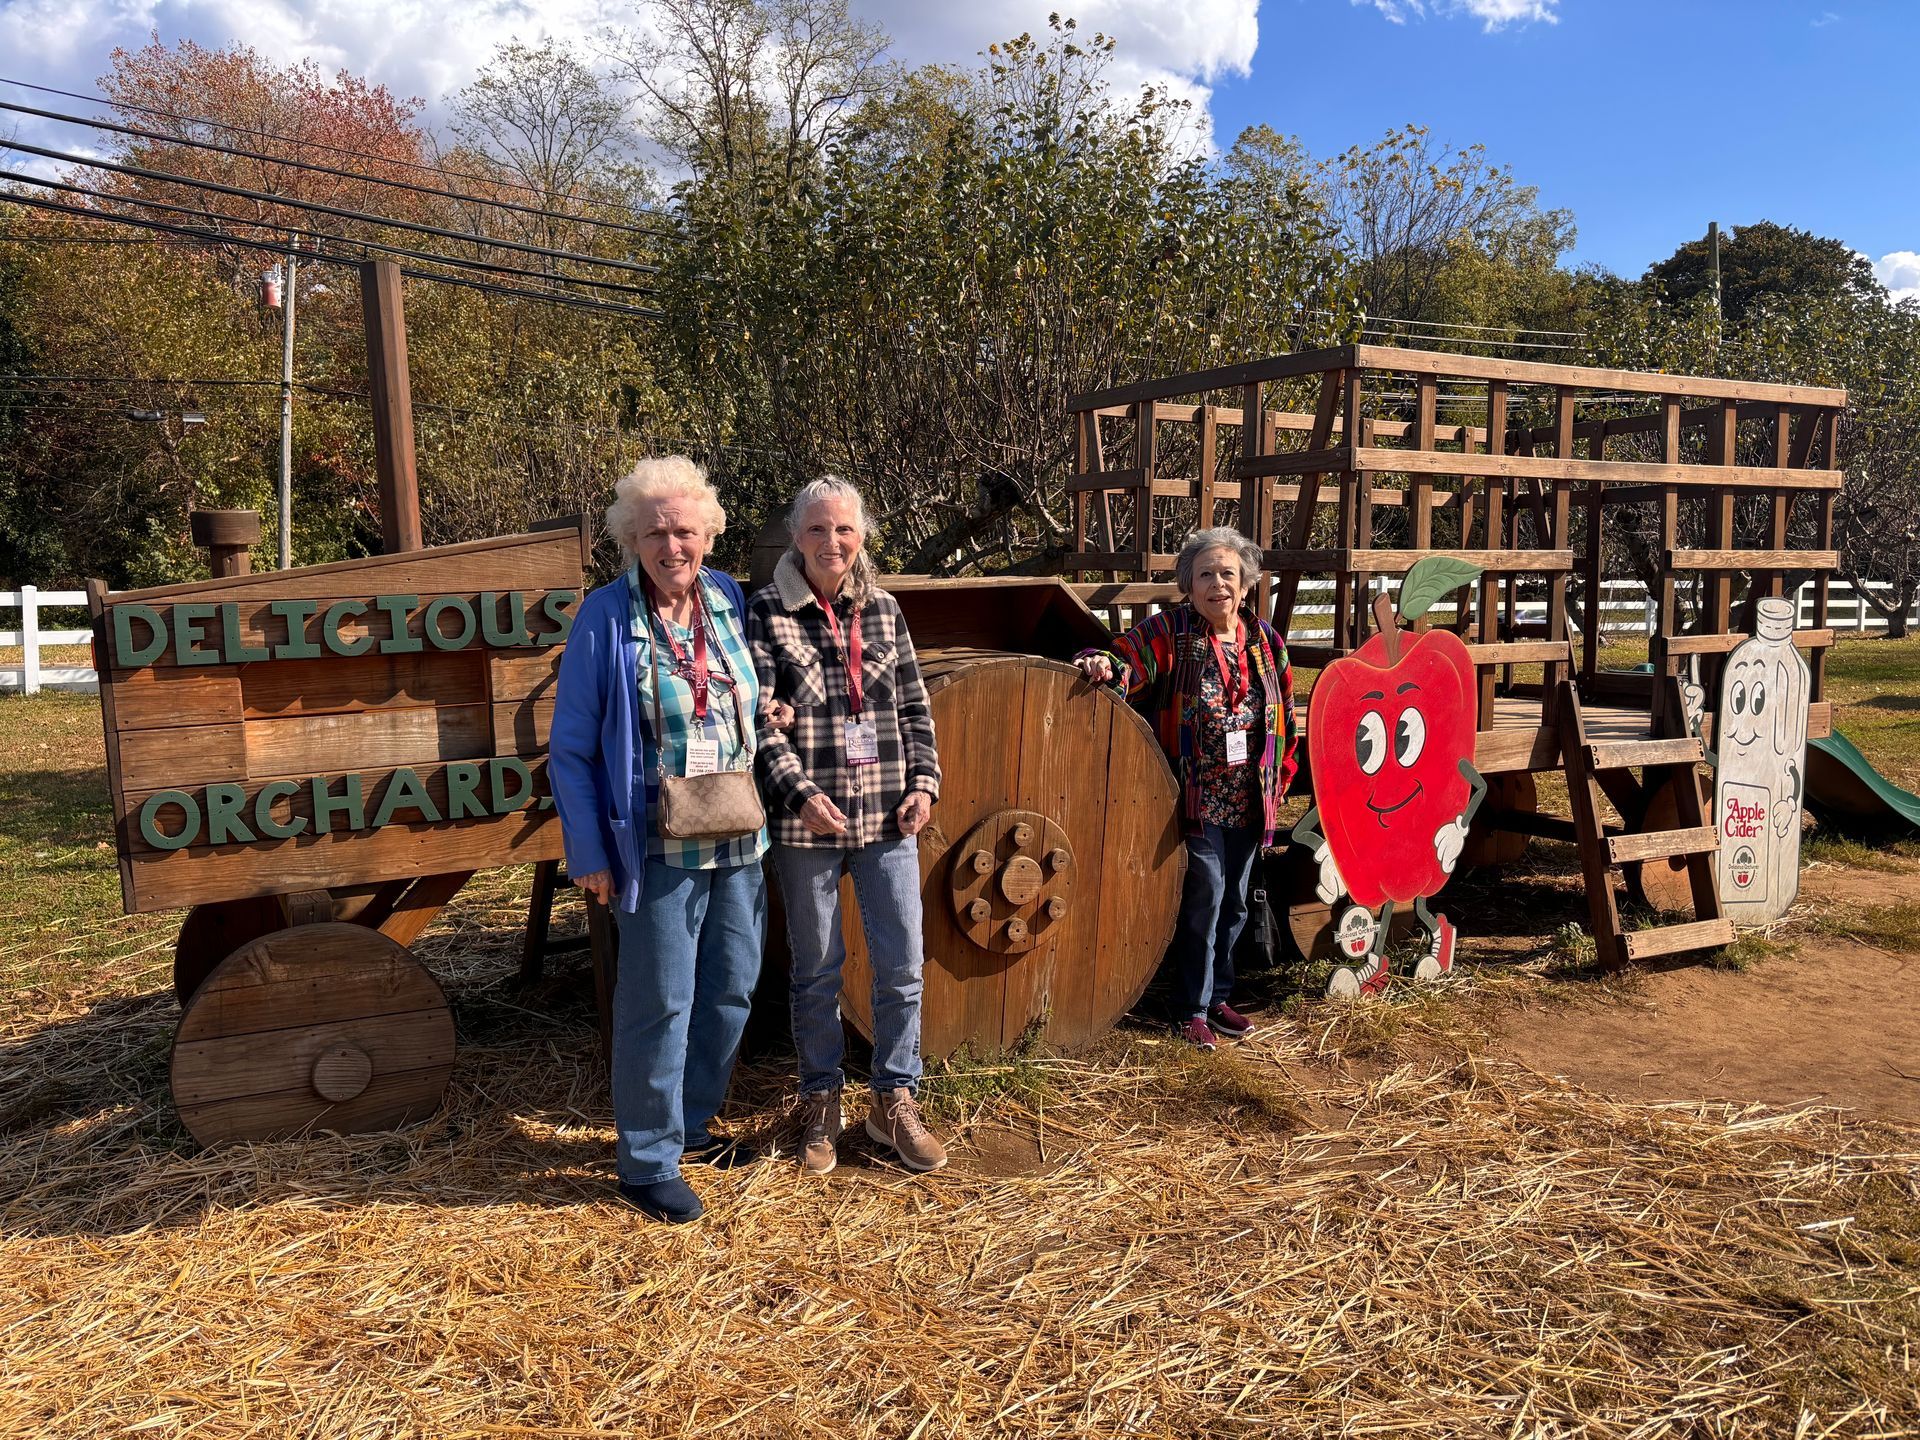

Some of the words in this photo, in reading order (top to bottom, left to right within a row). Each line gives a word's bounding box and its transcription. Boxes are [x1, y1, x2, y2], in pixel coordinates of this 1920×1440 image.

[112, 591, 577, 667] DELICIOUS
[139, 756, 556, 850] ORCHARD
[1724, 815, 1764, 838] Cider
[1726, 798, 1765, 823] Apple
